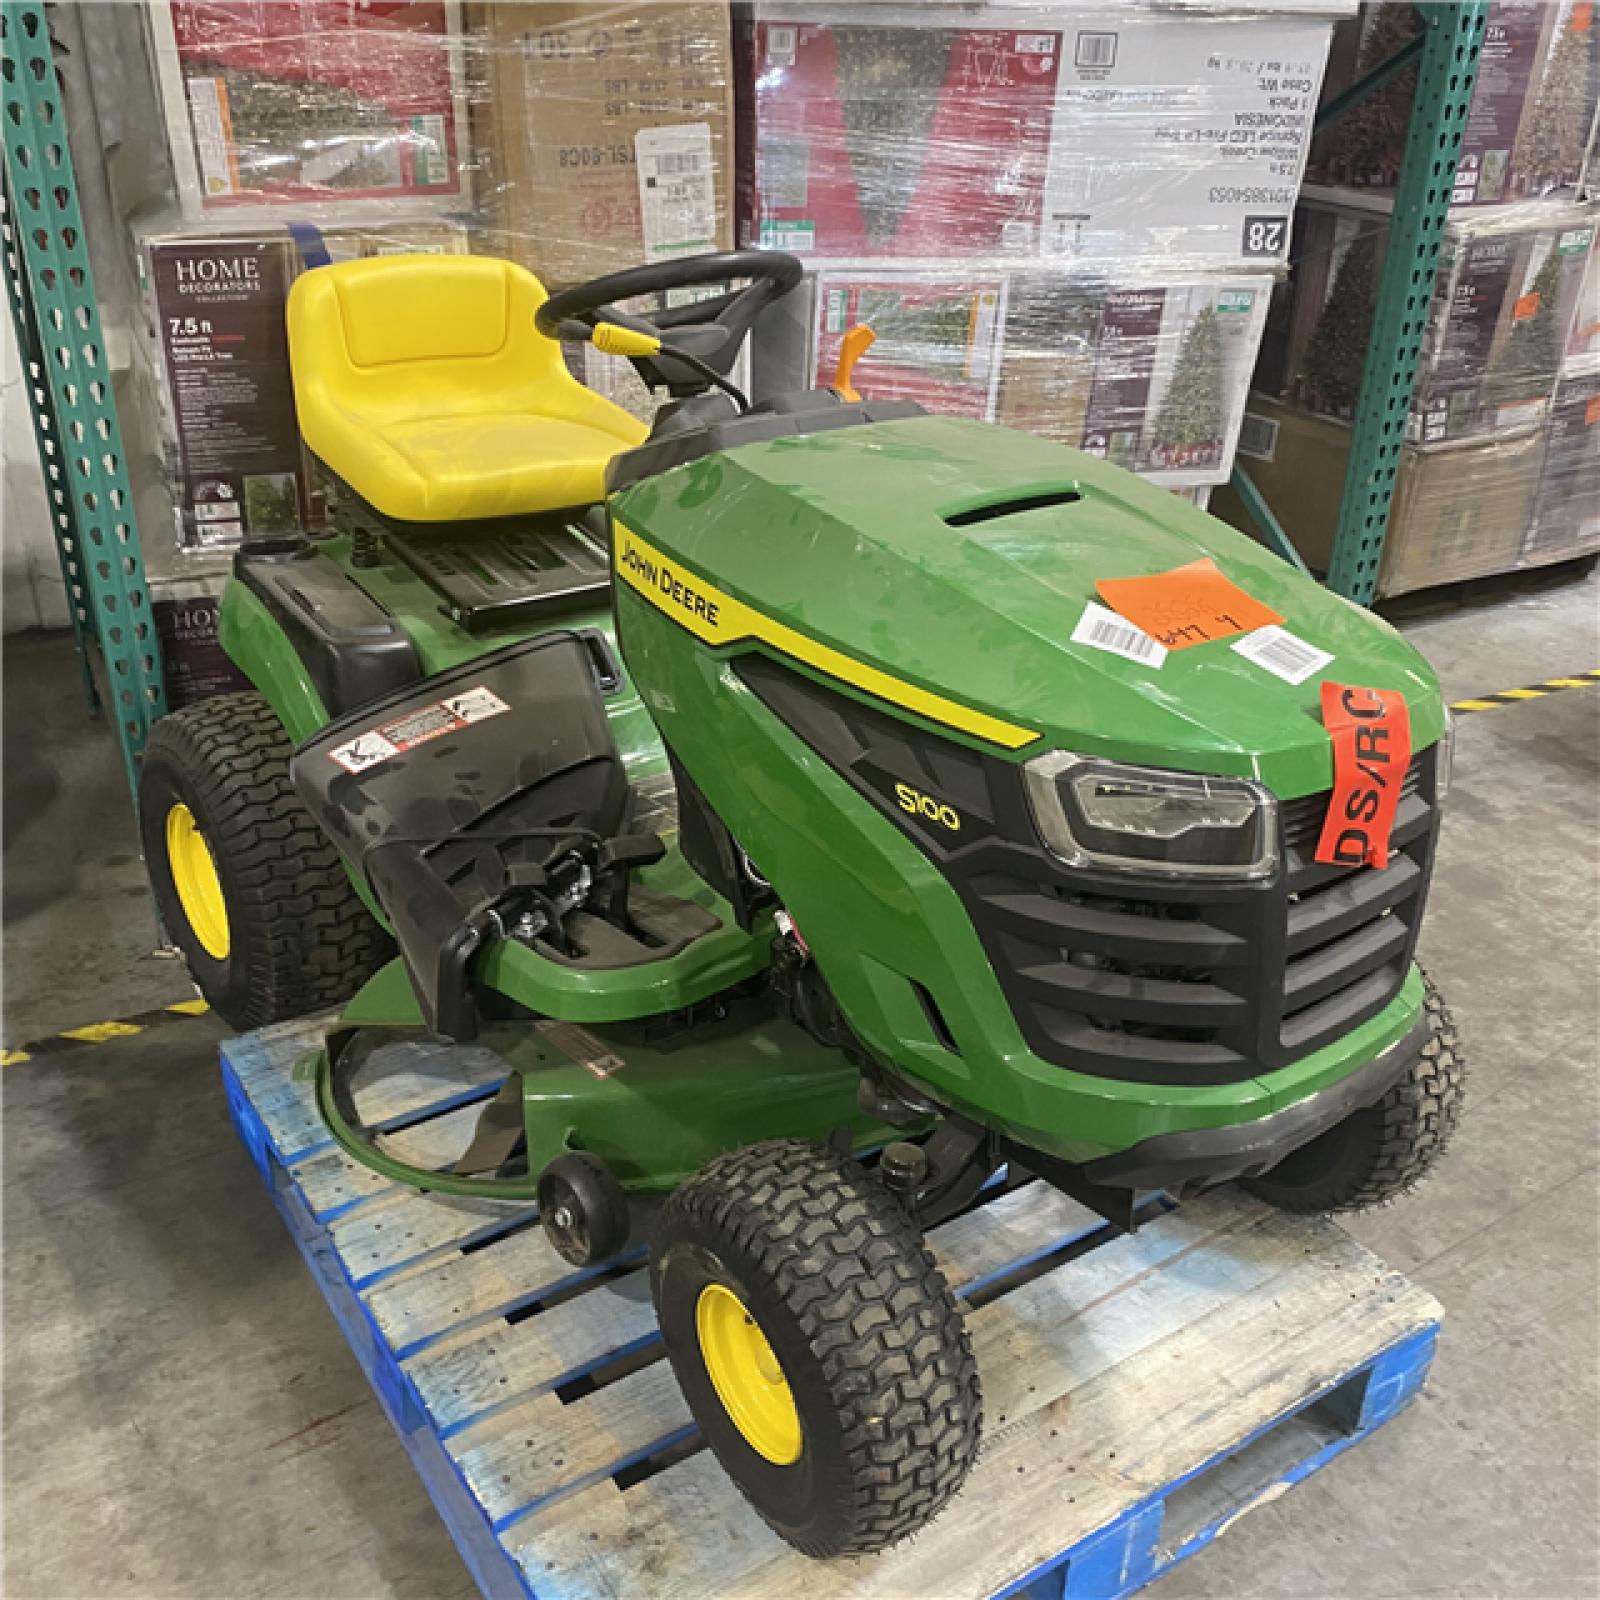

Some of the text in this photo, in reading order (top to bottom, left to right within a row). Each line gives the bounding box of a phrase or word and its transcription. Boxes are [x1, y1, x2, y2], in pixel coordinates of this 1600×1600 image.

[1249, 222, 1281, 251] 28
[175, 257, 260, 281] HOME
[177, 281, 261, 294] DECORATORS
[621, 540, 720, 628] JOHN DEERE
[894, 782, 961, 831] S100
